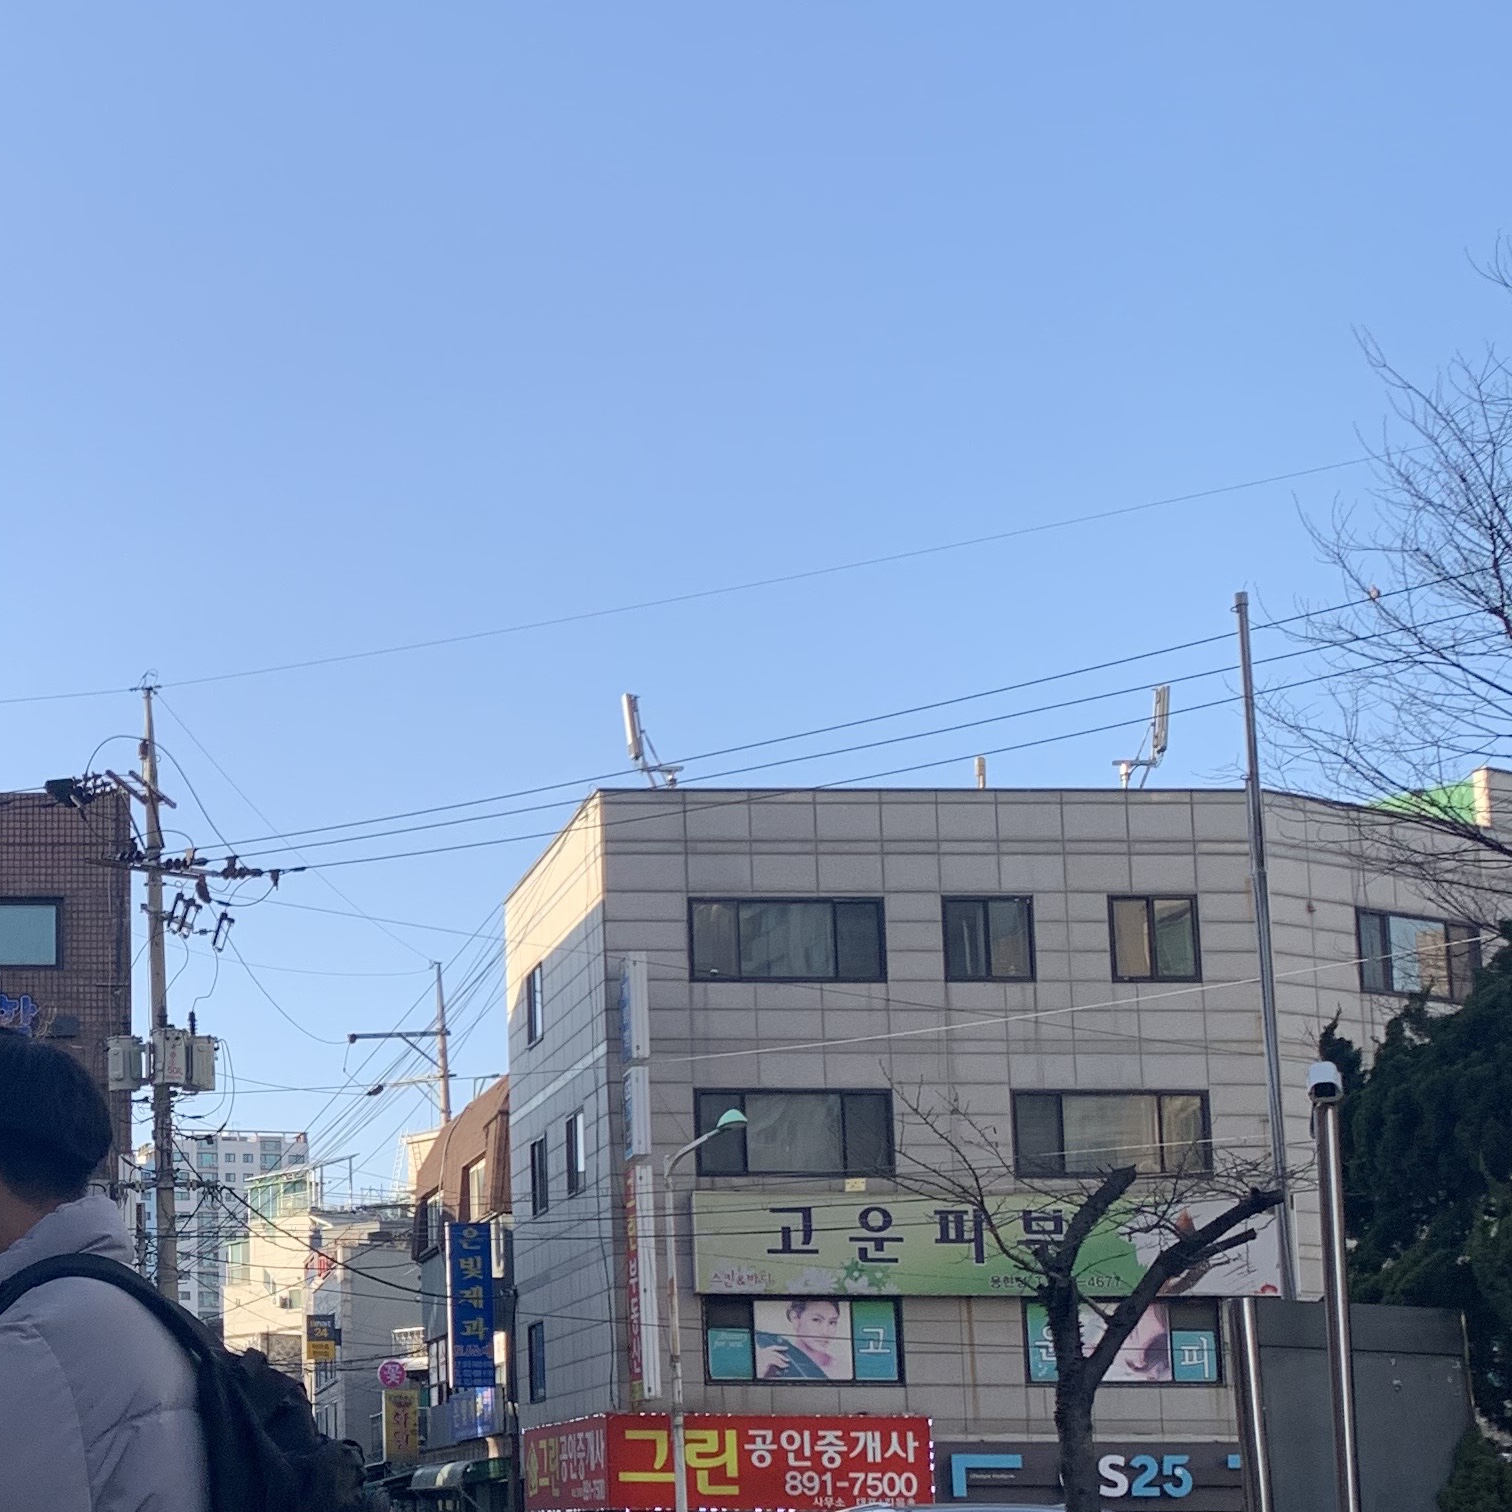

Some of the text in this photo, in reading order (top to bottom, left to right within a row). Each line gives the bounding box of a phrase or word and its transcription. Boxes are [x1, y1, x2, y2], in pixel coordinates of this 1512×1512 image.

[314, 1328, 329, 1338] 24
[858, 1328, 891, 1354] 고
[1180, 1336, 1210, 1380] 피
[618, 1429, 919, 1495] 그린 공인중개사
[785, 1470, 918, 1497] 891-7500
